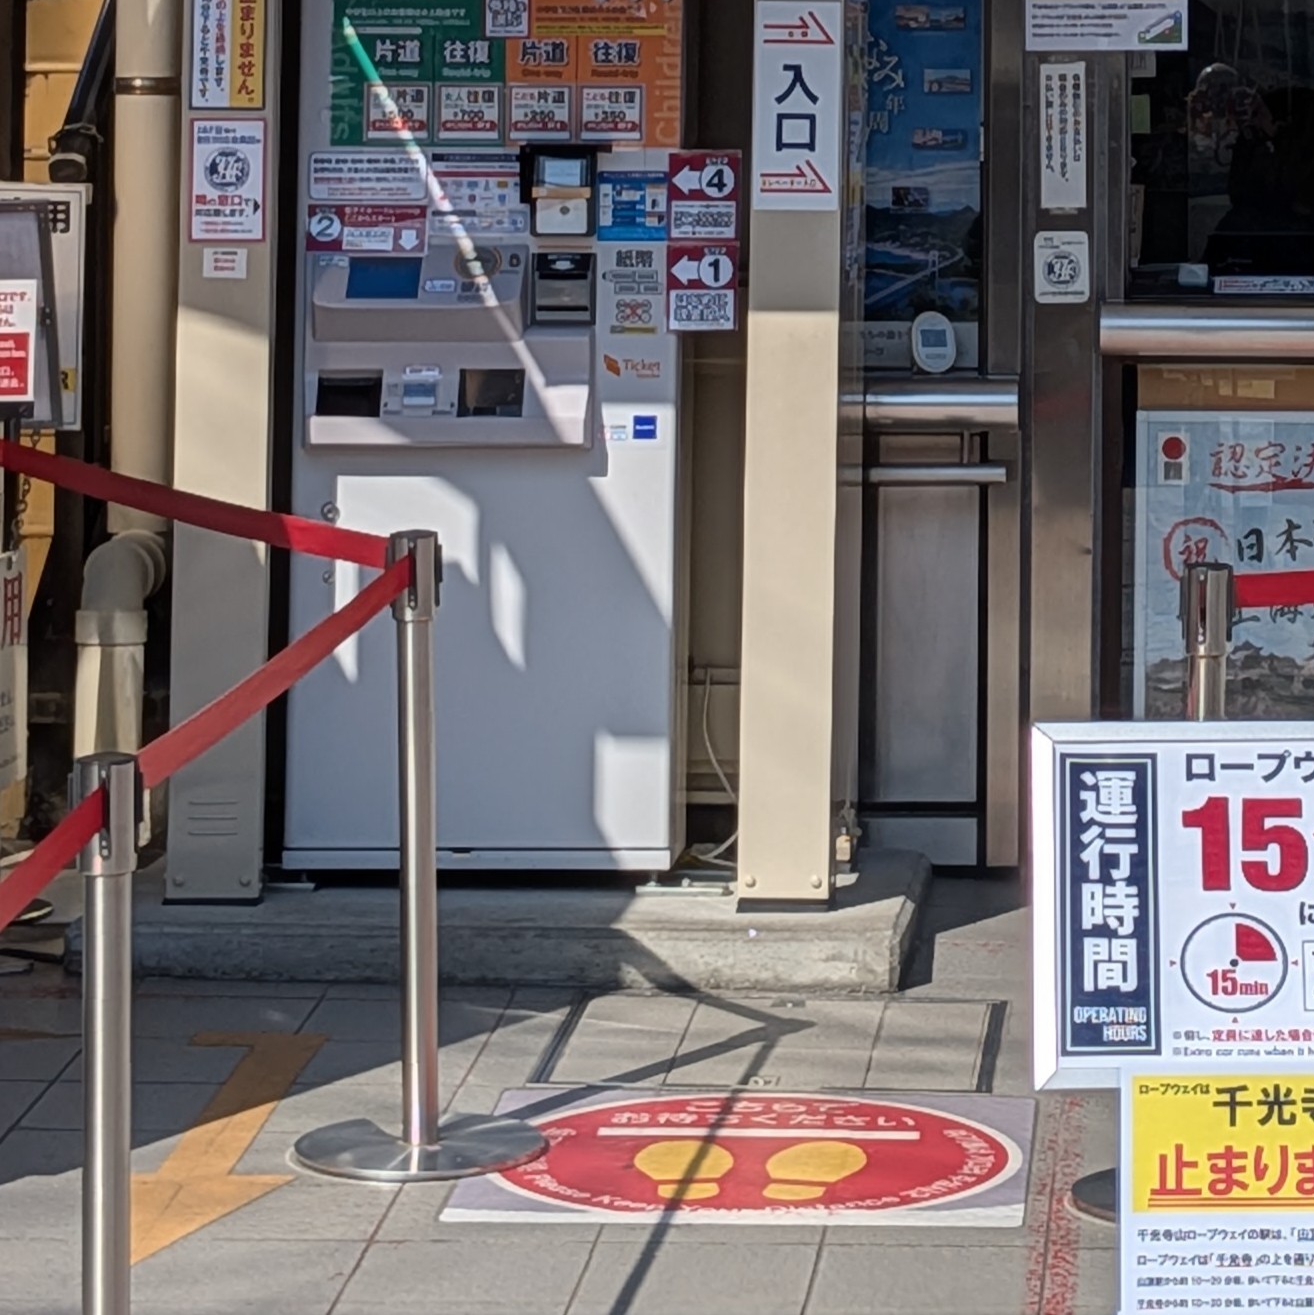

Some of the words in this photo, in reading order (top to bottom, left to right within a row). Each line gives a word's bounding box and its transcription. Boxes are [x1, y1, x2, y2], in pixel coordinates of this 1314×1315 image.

[374, 39, 421, 64] 片道
[443, 39, 490, 64] 往復
[519, 39, 568, 66] 片道
[591, 39, 641, 66] 往復
[774, 63, 820, 152] 入口
[706, 169, 728, 192] 4
[315, 214, 335, 238] 2
[708, 258, 722, 283] 1
[622, 358, 661, 373] Ticket
[1079, 769, 1140, 994] 運行時間
[1073, 1005, 1147, 1024] OPERATING
[1103, 1024, 1148, 1043] HOURS
[1138, 1083, 1211, 1095] ロープウェイは
[611, 1111, 917, 1127] お待ちください
